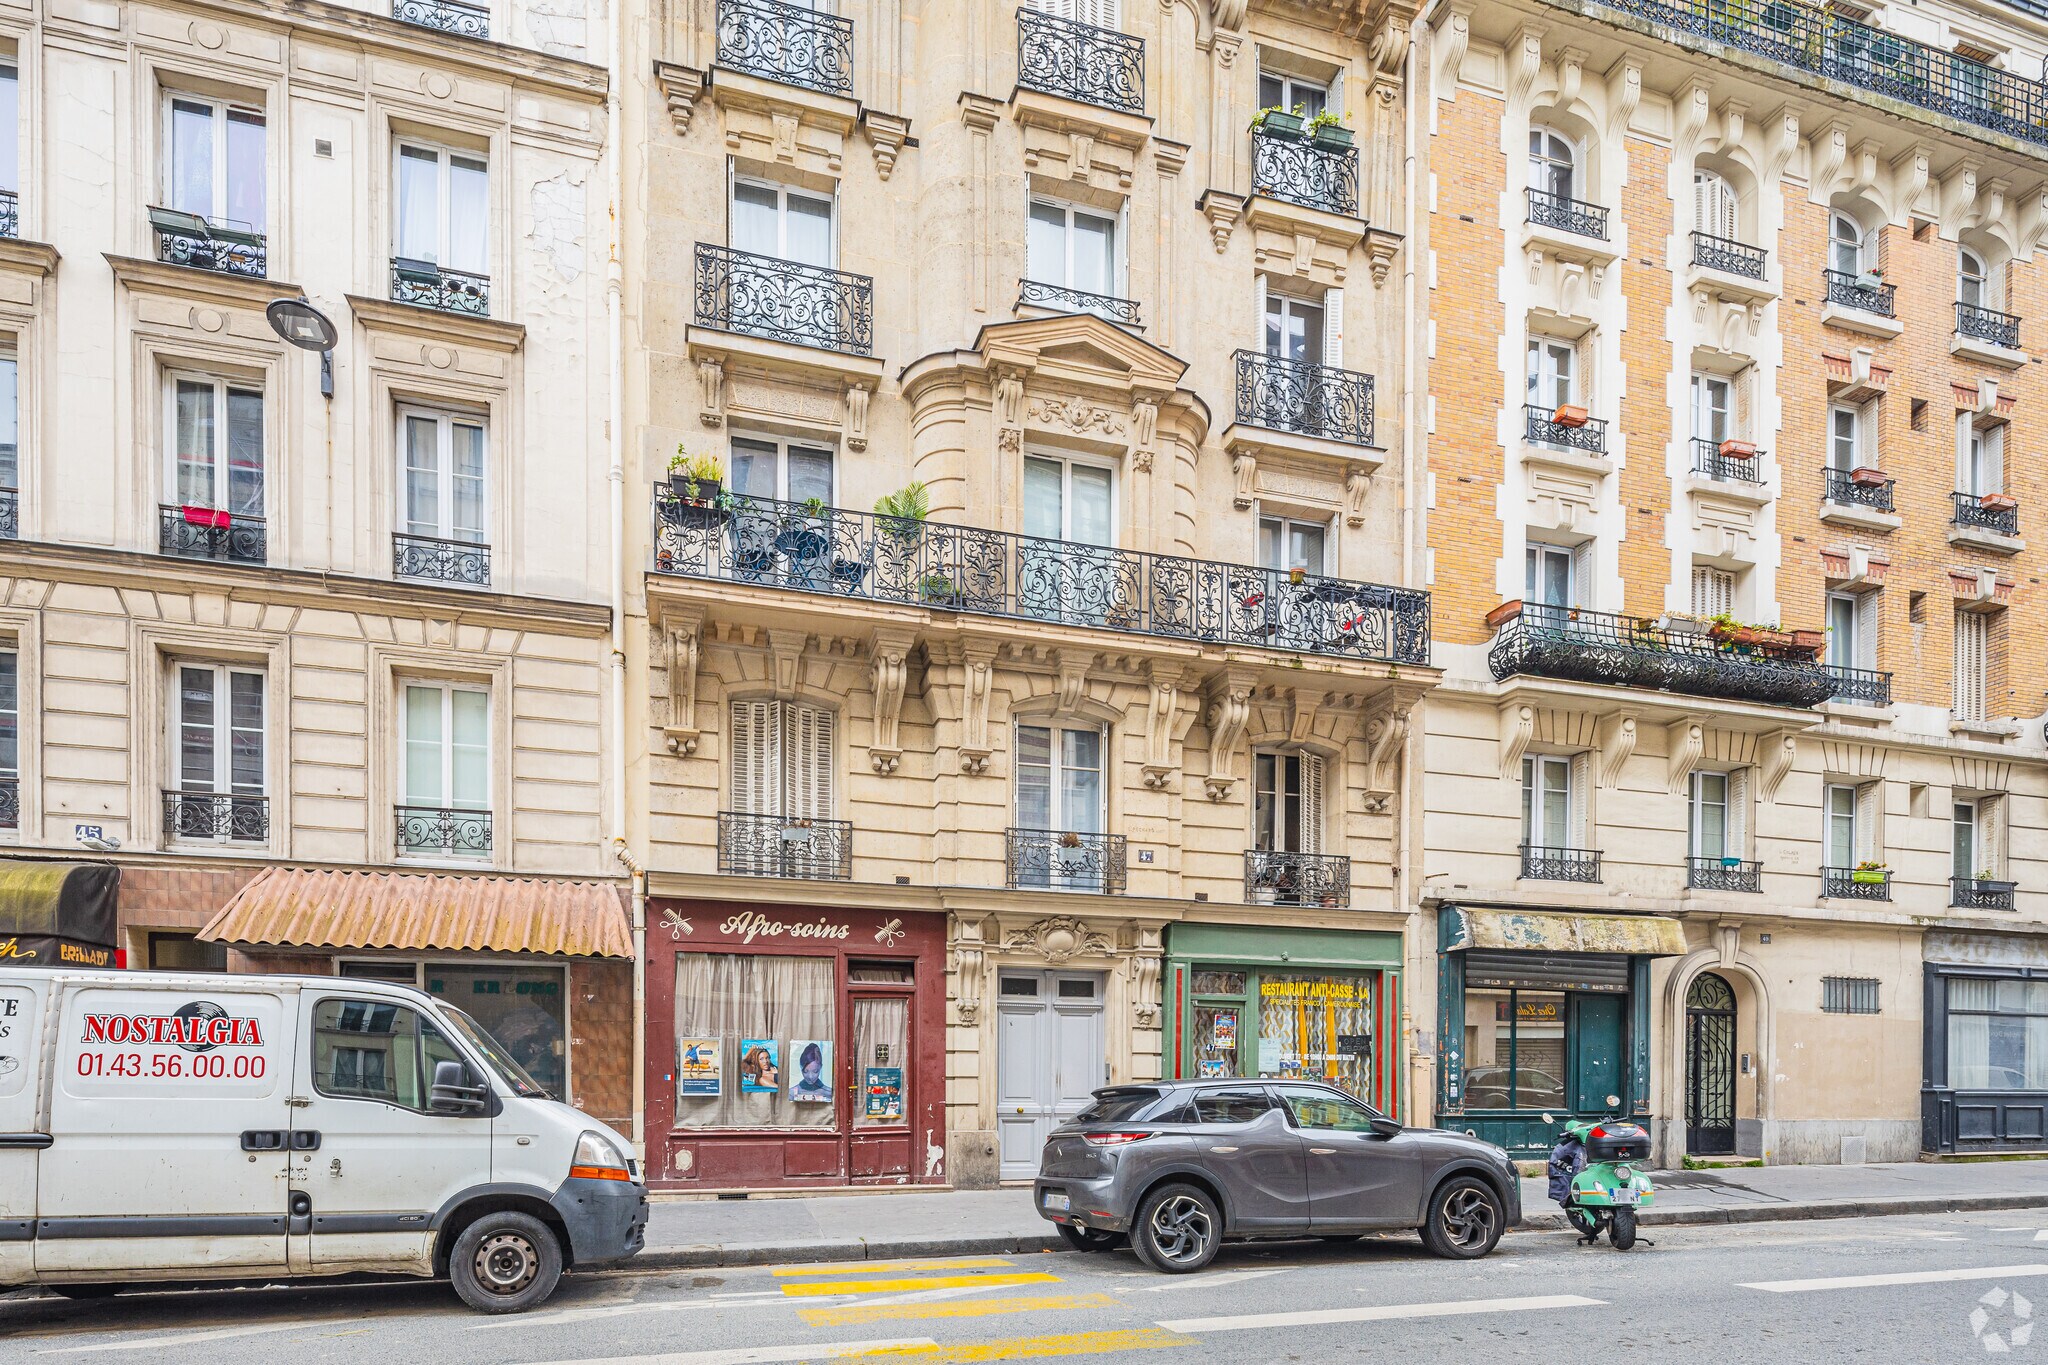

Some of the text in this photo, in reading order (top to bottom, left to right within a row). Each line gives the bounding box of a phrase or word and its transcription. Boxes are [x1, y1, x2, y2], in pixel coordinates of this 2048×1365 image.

[76, 826, 100, 838] 45
[1140, 851, 1152, 861] 47
[719, 911, 850, 944] Afro-soins
[1261, 982, 1309, 996] RESTAURANT
[1311, 983, 1353, 999] ANTI-CASSE
[1301, 999, 1320, 1007] FRANCO
[81, 1013, 264, 1046] NOSTALGIA
[1343, 1037, 1368, 1045] OPEN
[77, 1052, 266, 1079] 01.43.56.00.00
